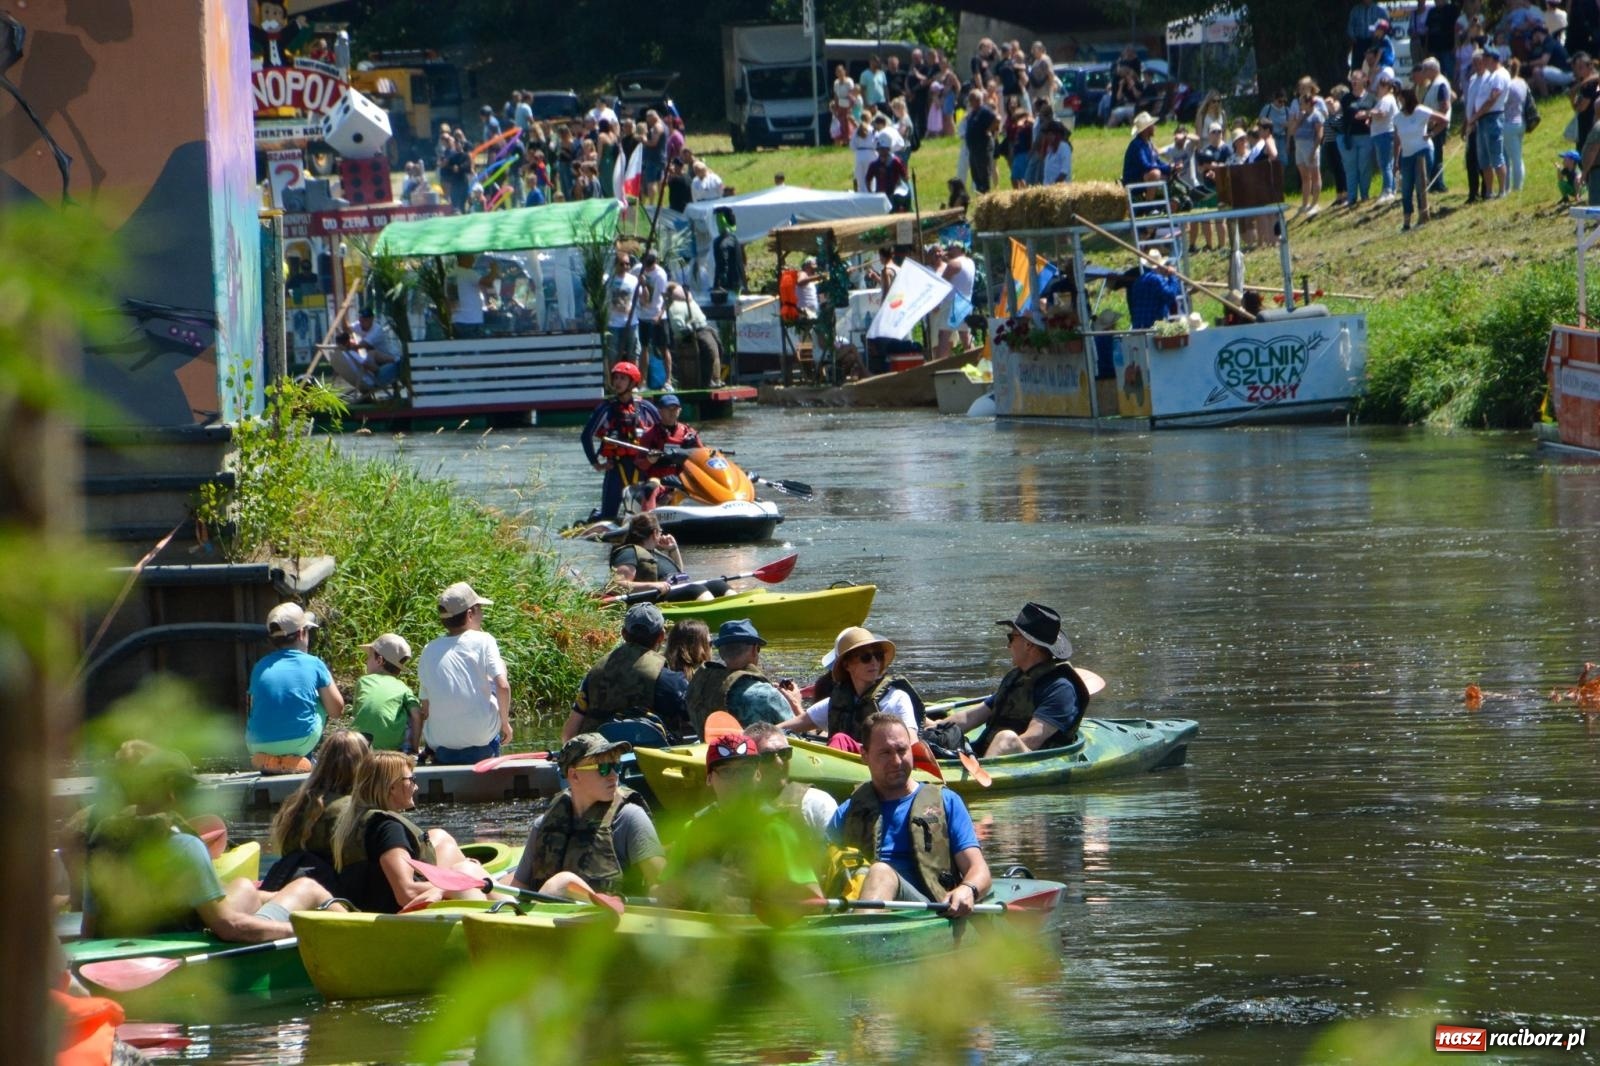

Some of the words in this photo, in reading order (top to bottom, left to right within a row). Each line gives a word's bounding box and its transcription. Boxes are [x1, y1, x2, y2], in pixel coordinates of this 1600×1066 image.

[322, 217, 338, 230] OD
[341, 215, 370, 229] ZERA
[372, 214, 388, 227] DO
[1217, 344, 1305, 370] ROLNIK
[1226, 366, 1302, 388] SZUKA
